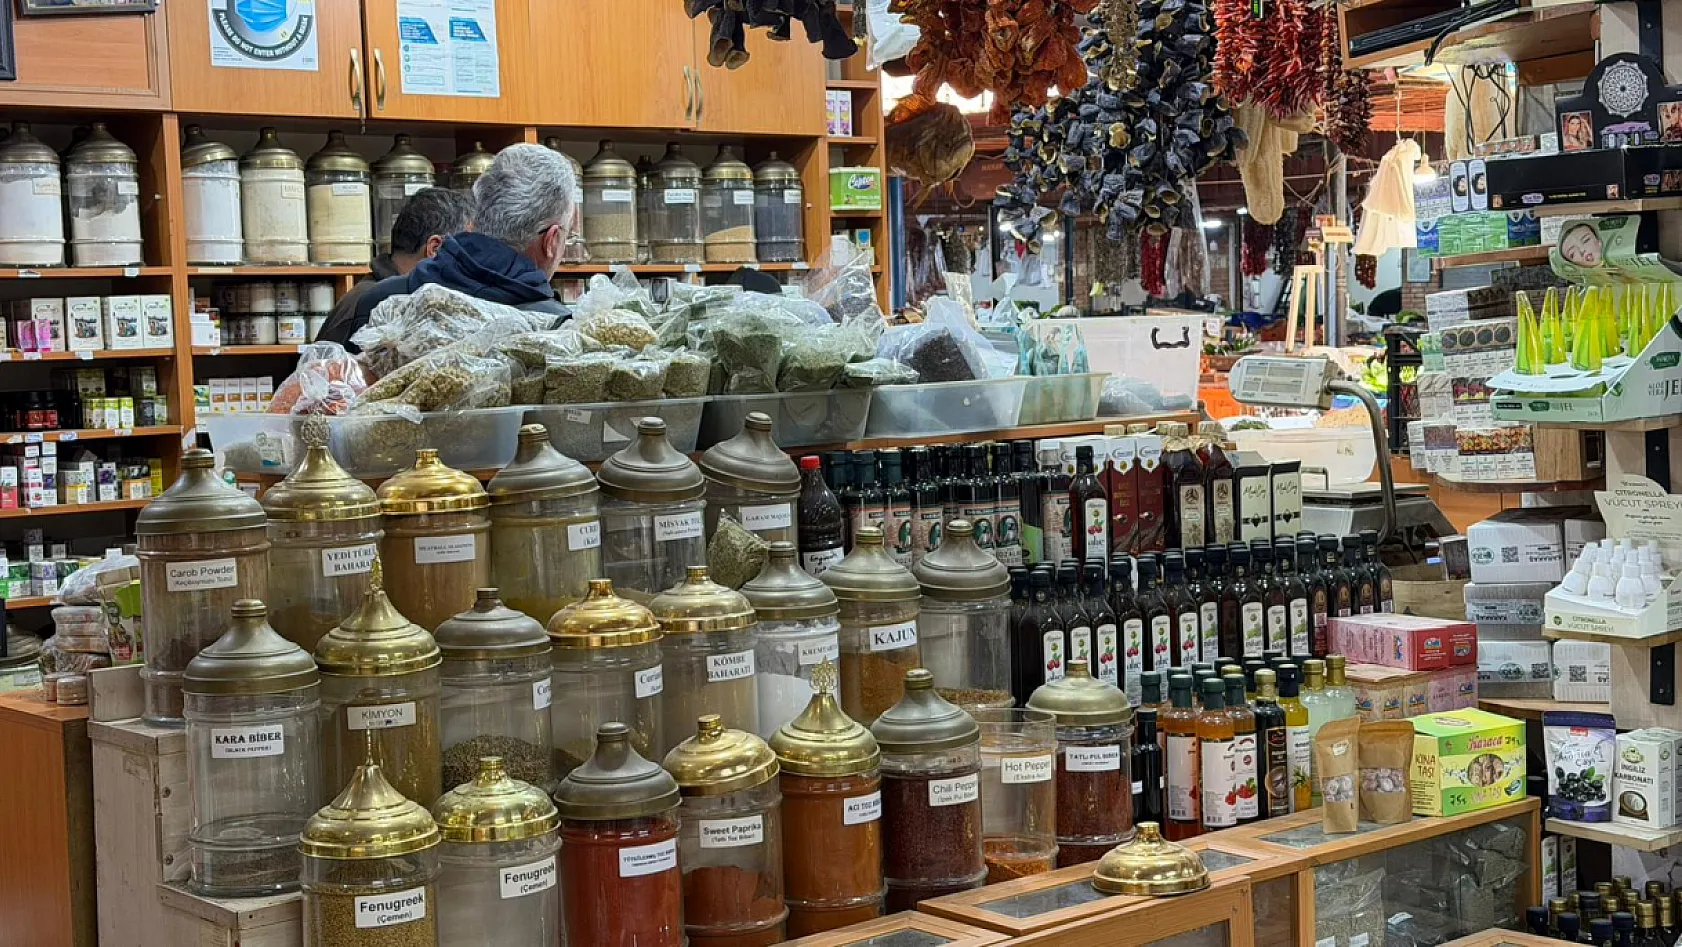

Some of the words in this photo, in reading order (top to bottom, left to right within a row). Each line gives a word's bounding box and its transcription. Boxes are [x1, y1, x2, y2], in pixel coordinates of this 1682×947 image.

[170, 568, 199, 578] Carob
[200, 565, 235, 577] Powder
[361, 707, 403, 720] KİMYON
[215, 734, 246, 745] KARA
[1004, 761, 1023, 772] Hot
[932, 784, 954, 795] Chili
[703, 827, 730, 836] Sweet
[731, 822, 762, 834] Paprika
[504, 861, 556, 885] Fenugreek
[360, 892, 424, 913] Fenugreek
[376, 910, 413, 924] (Çemen)
